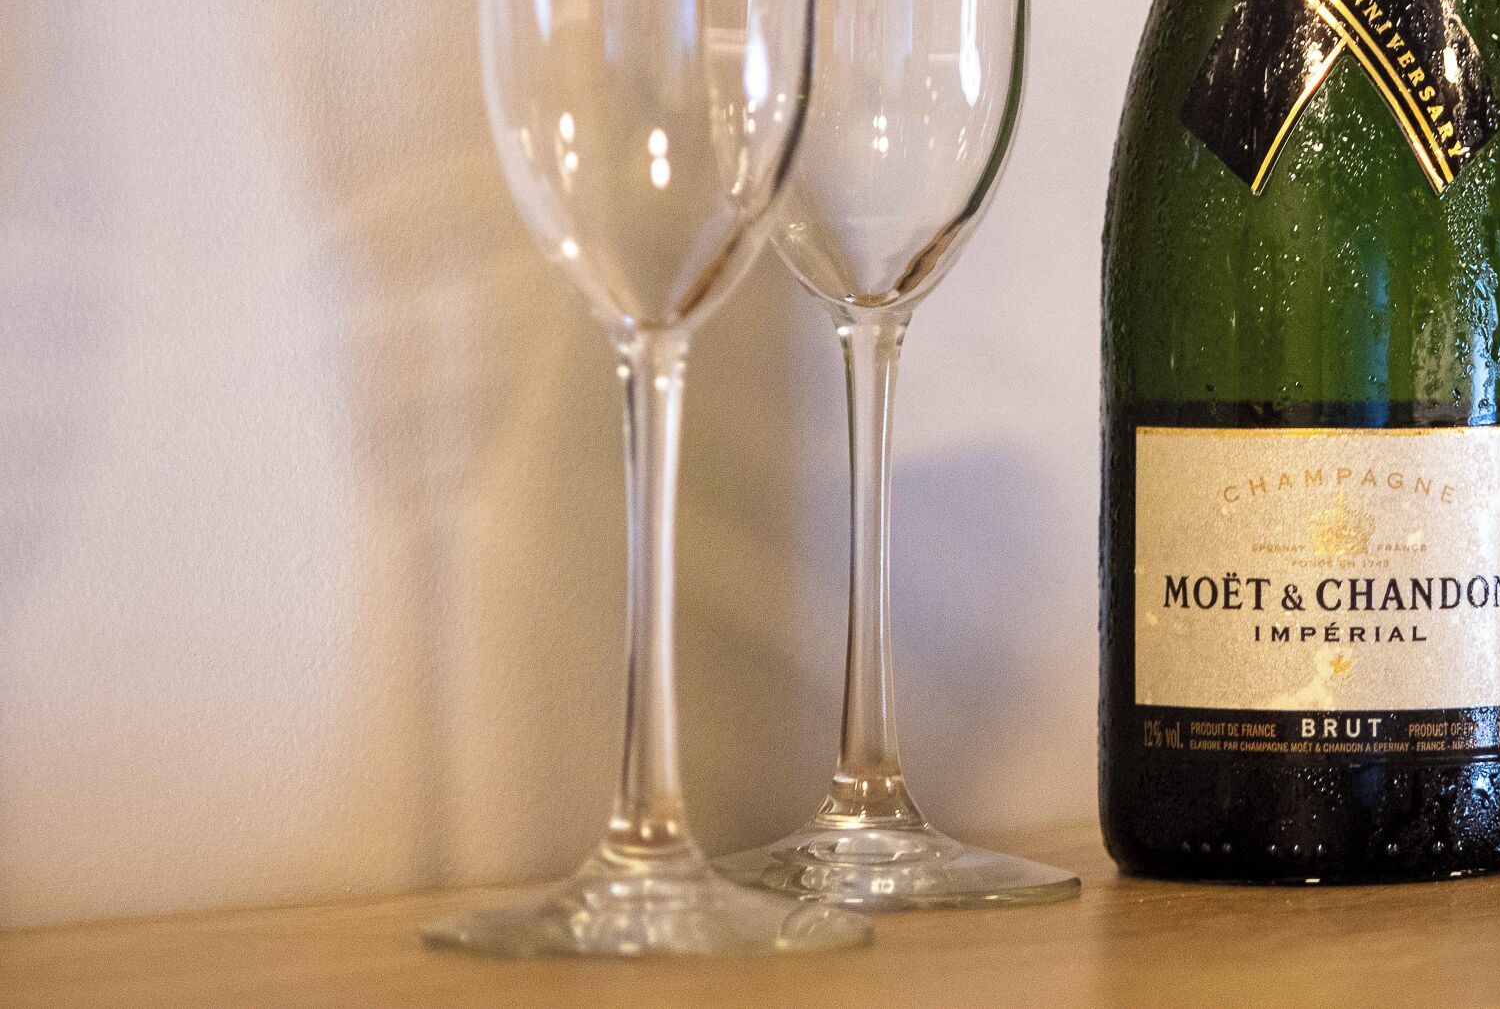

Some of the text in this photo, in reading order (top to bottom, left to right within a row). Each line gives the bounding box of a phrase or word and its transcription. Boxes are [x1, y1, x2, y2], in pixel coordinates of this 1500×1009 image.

[1223, 466, 1456, 504] CHAMPAGNE
[1376, 542, 1428, 553] FRANCE
[1162, 572, 1271, 611] MOËT
[1281, 583, 1307, 612] &
[1255, 621, 1428, 643] IMPÉRIAL
[1143, 718, 1184, 750] 12% vol.
[1190, 721, 1277, 739] PRODUIT DE FRANCE
[1301, 717, 1382, 738] BRUT
[1408, 722, 1449, 738] PRODUCT
[1450, 722, 1461, 737] OF
[1240, 741, 1289, 753] CHAMPAGNE
[1323, 742, 1363, 753] CHANDON
[1416, 741, 1446, 752] FRANCE
